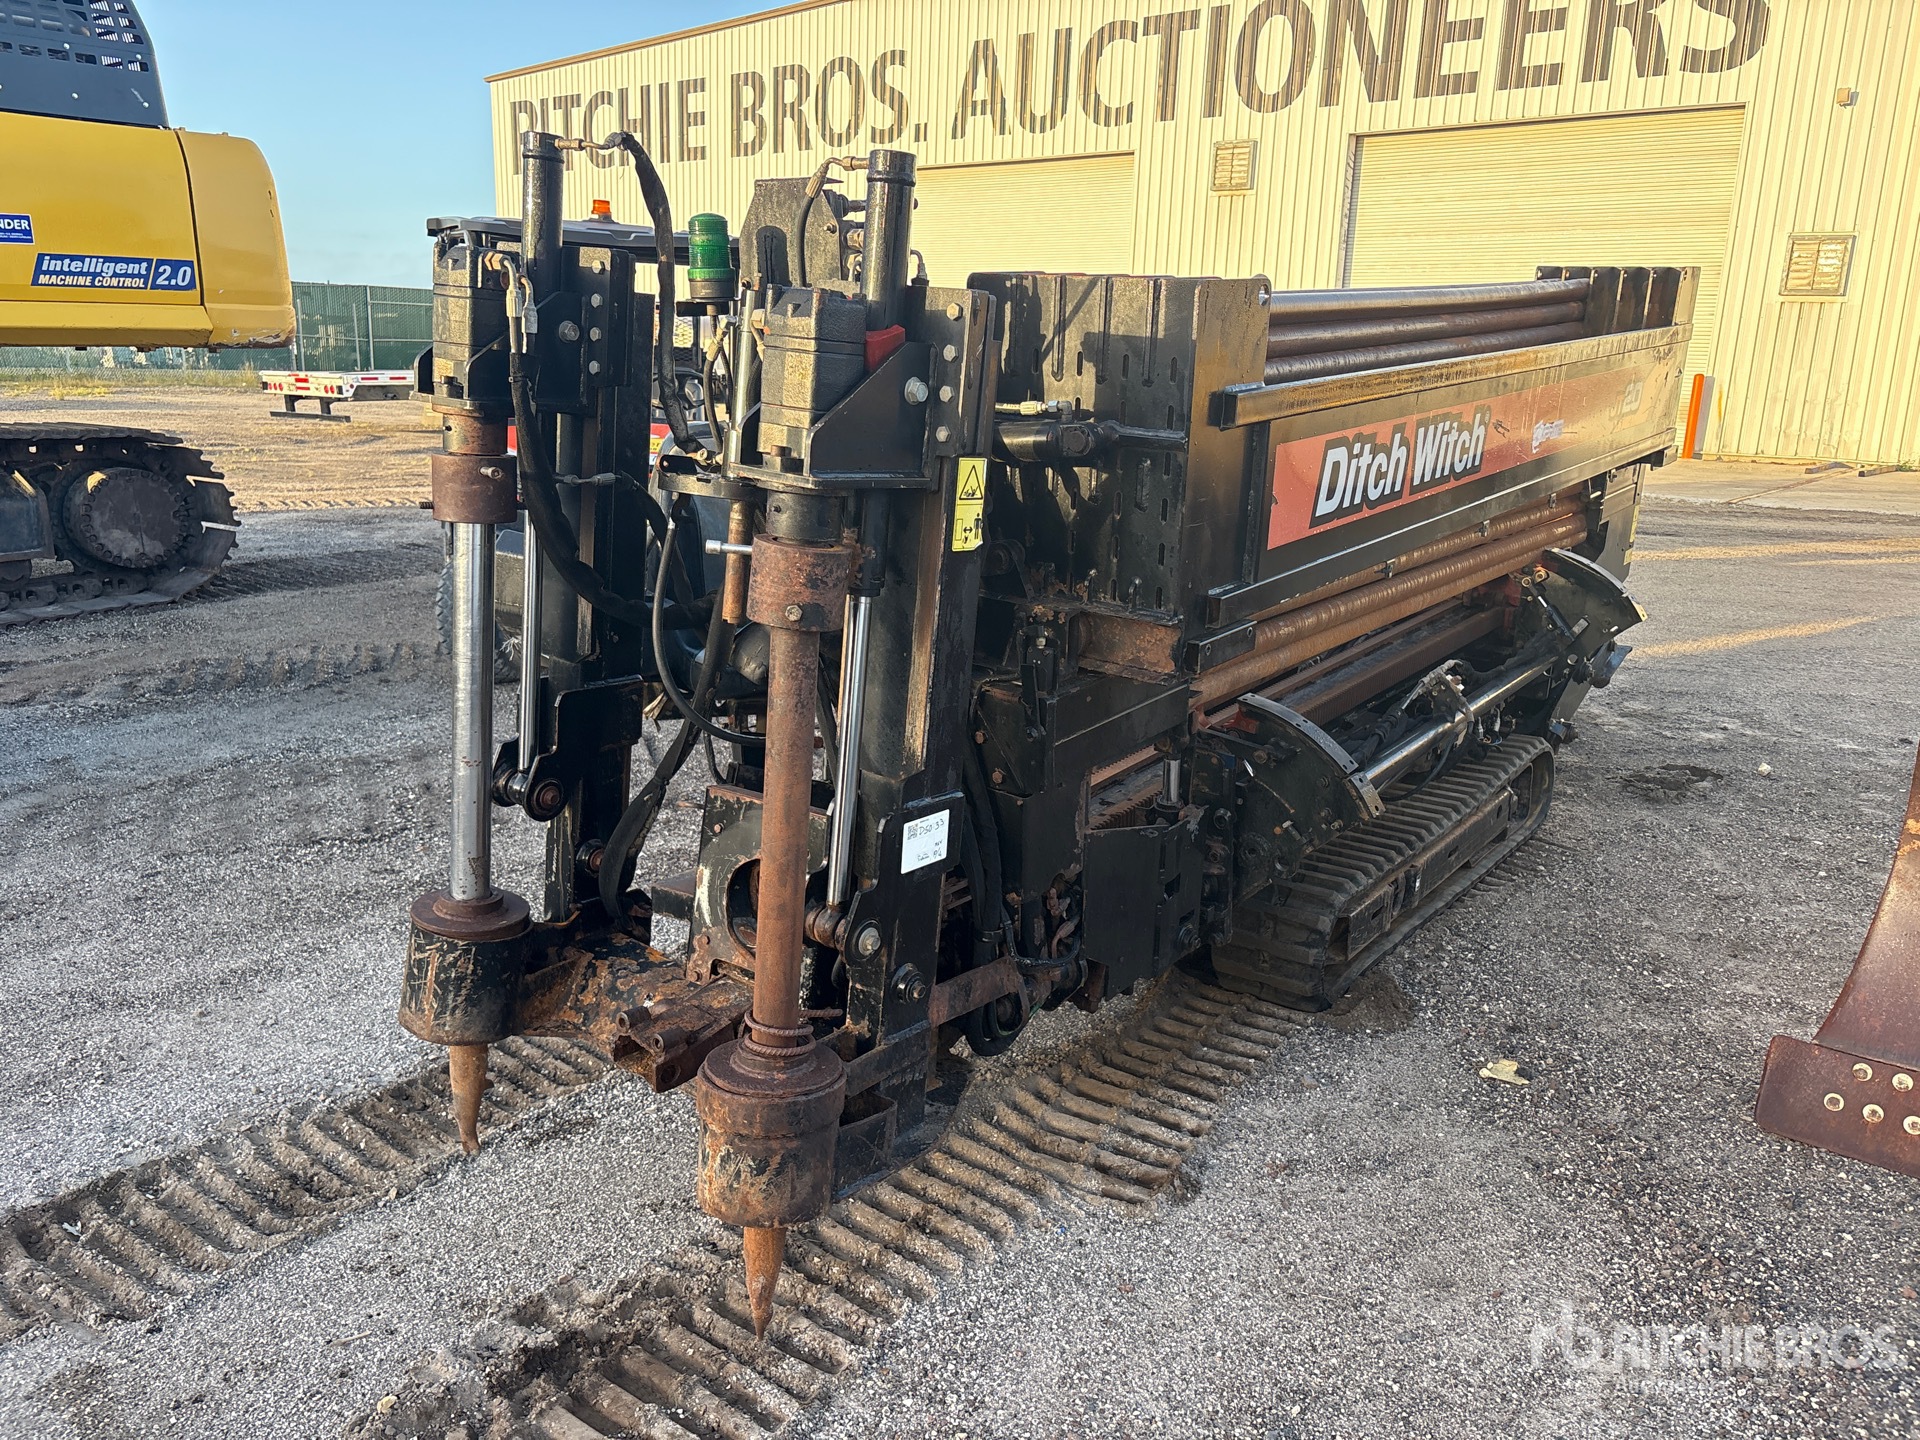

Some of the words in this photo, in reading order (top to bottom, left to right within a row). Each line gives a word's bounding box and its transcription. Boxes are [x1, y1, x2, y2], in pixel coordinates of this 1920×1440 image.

[731, 49, 928, 158] BROS.
[951, 0, 1771, 140] AUCTIONEERS
[38, 274, 93, 286] MACHINE
[94, 276, 146, 288] CONTROL
[41, 256, 148, 277] intelligent
[155, 265, 192, 286] 2.0
[1315, 433, 1408, 517] Ditch
[1413, 413, 1486, 487] Witch
